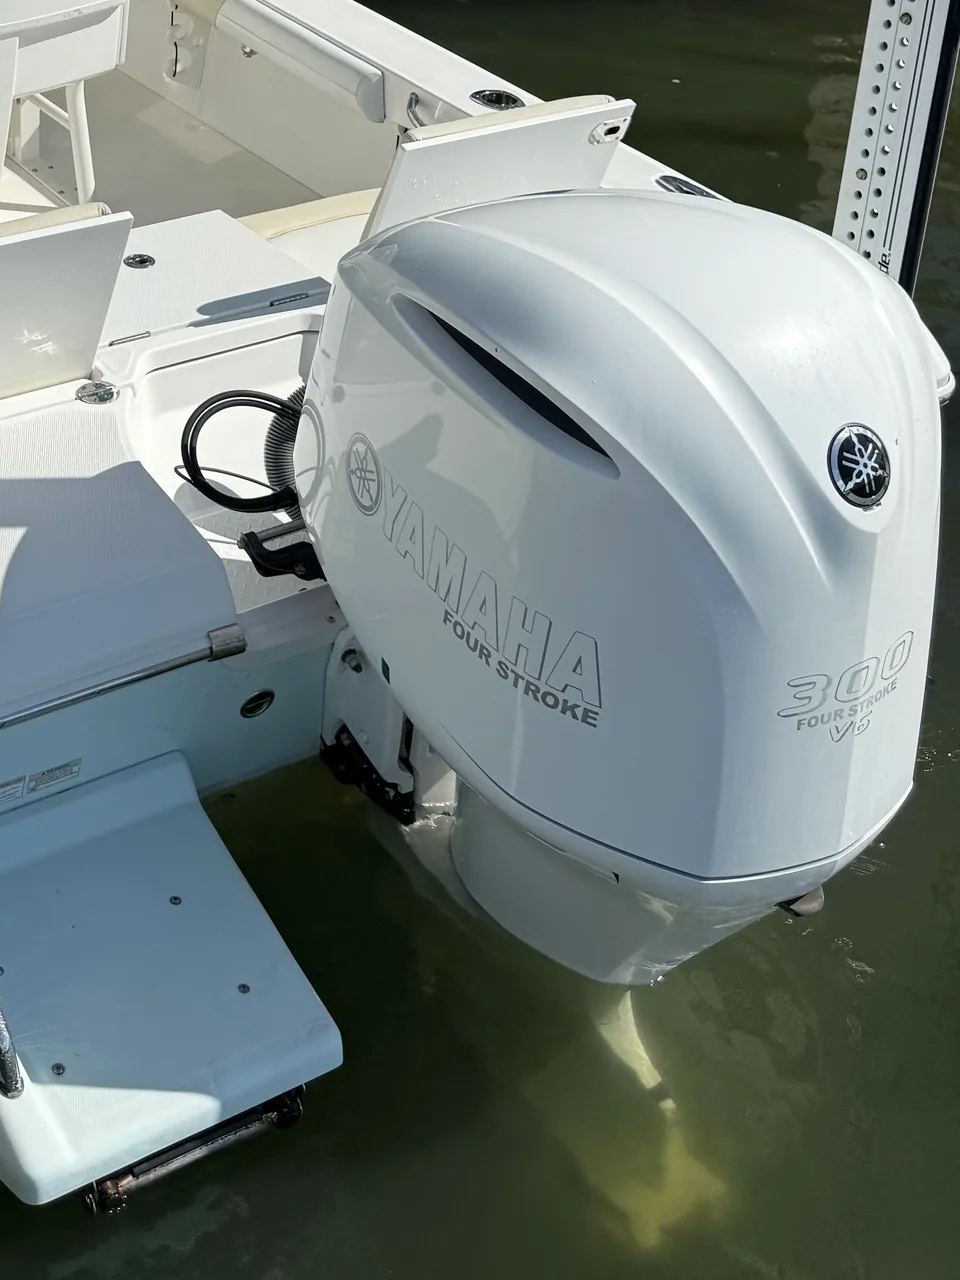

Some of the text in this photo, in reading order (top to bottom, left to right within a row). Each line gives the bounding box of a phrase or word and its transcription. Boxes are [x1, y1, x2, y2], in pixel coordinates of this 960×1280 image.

[382, 465, 602, 708] YAMAHA
[442, 608, 599, 728] FOUR STROKE
[777, 630, 914, 718] 300
[797, 677, 898, 731] FOUR STROKE
[829, 710, 873, 743] V6
